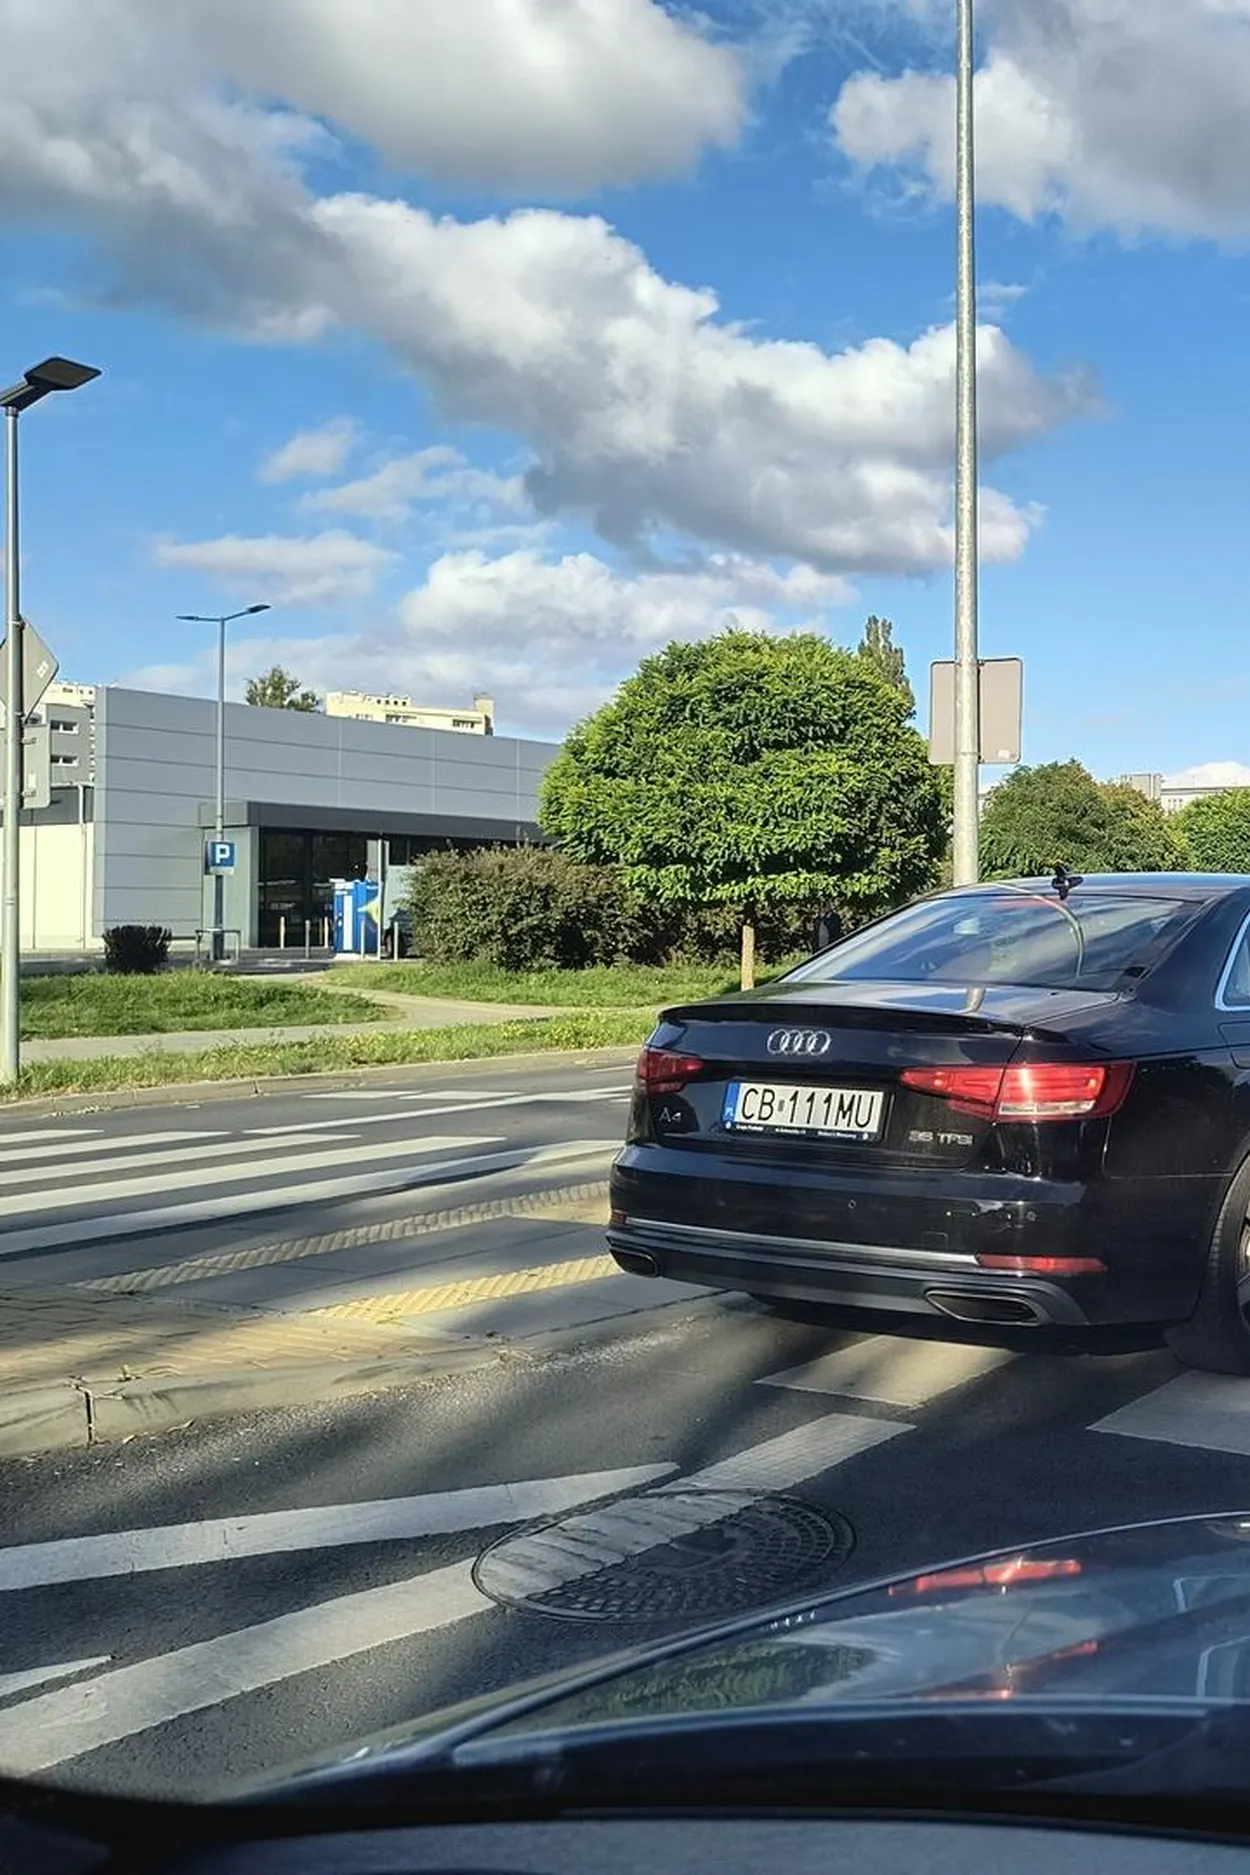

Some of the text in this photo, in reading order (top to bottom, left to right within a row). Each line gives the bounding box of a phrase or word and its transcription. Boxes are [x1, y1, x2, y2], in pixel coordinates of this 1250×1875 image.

[215, 843, 231, 864] P
[741, 1088, 875, 1128] CB 111MU
